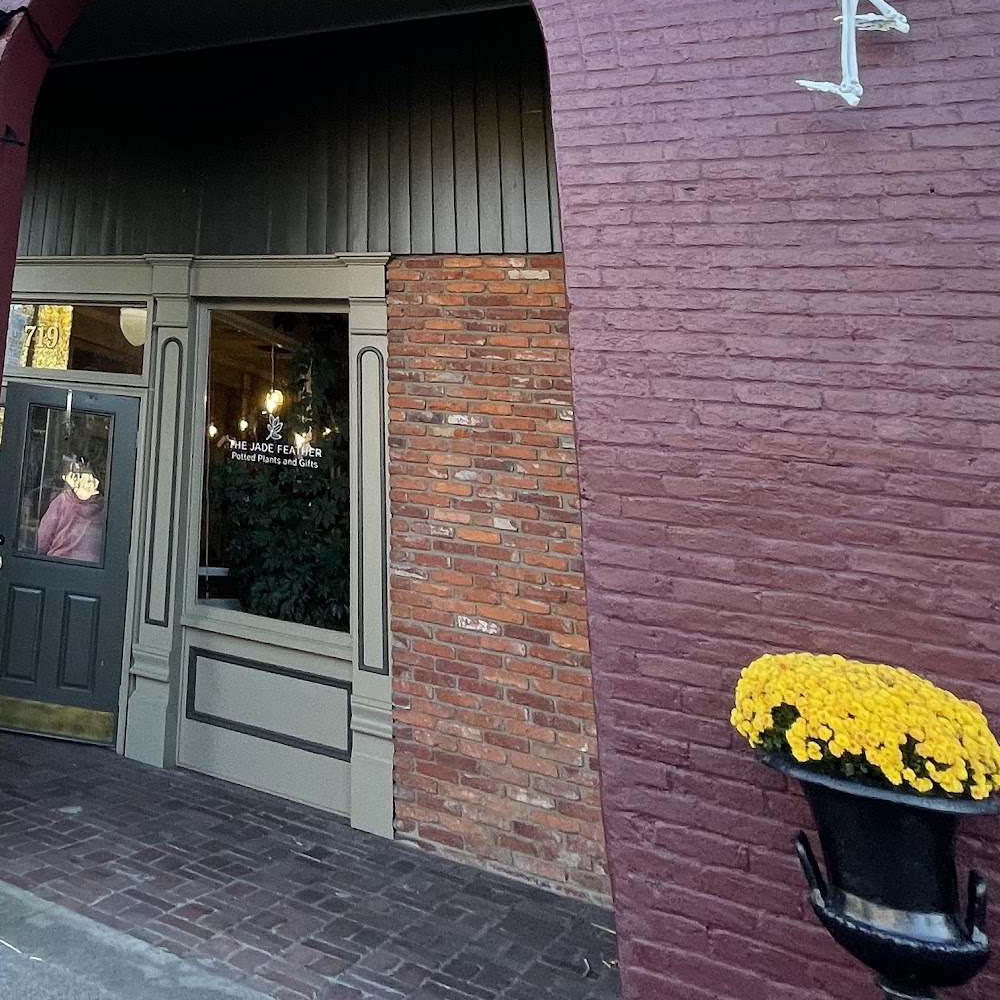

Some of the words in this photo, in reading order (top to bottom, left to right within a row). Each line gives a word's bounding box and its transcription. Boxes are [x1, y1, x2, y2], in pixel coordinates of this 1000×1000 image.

[24, 325, 60, 349] 719
[230, 440, 247, 450] THE
[250, 442, 275, 453] JADE
[277, 445, 322, 457] FEATHER
[231, 451, 256, 461] Potted
[257, 454, 281, 465] Plants
[282, 458, 298, 467] and
[299, 459, 318, 468] Gifts
